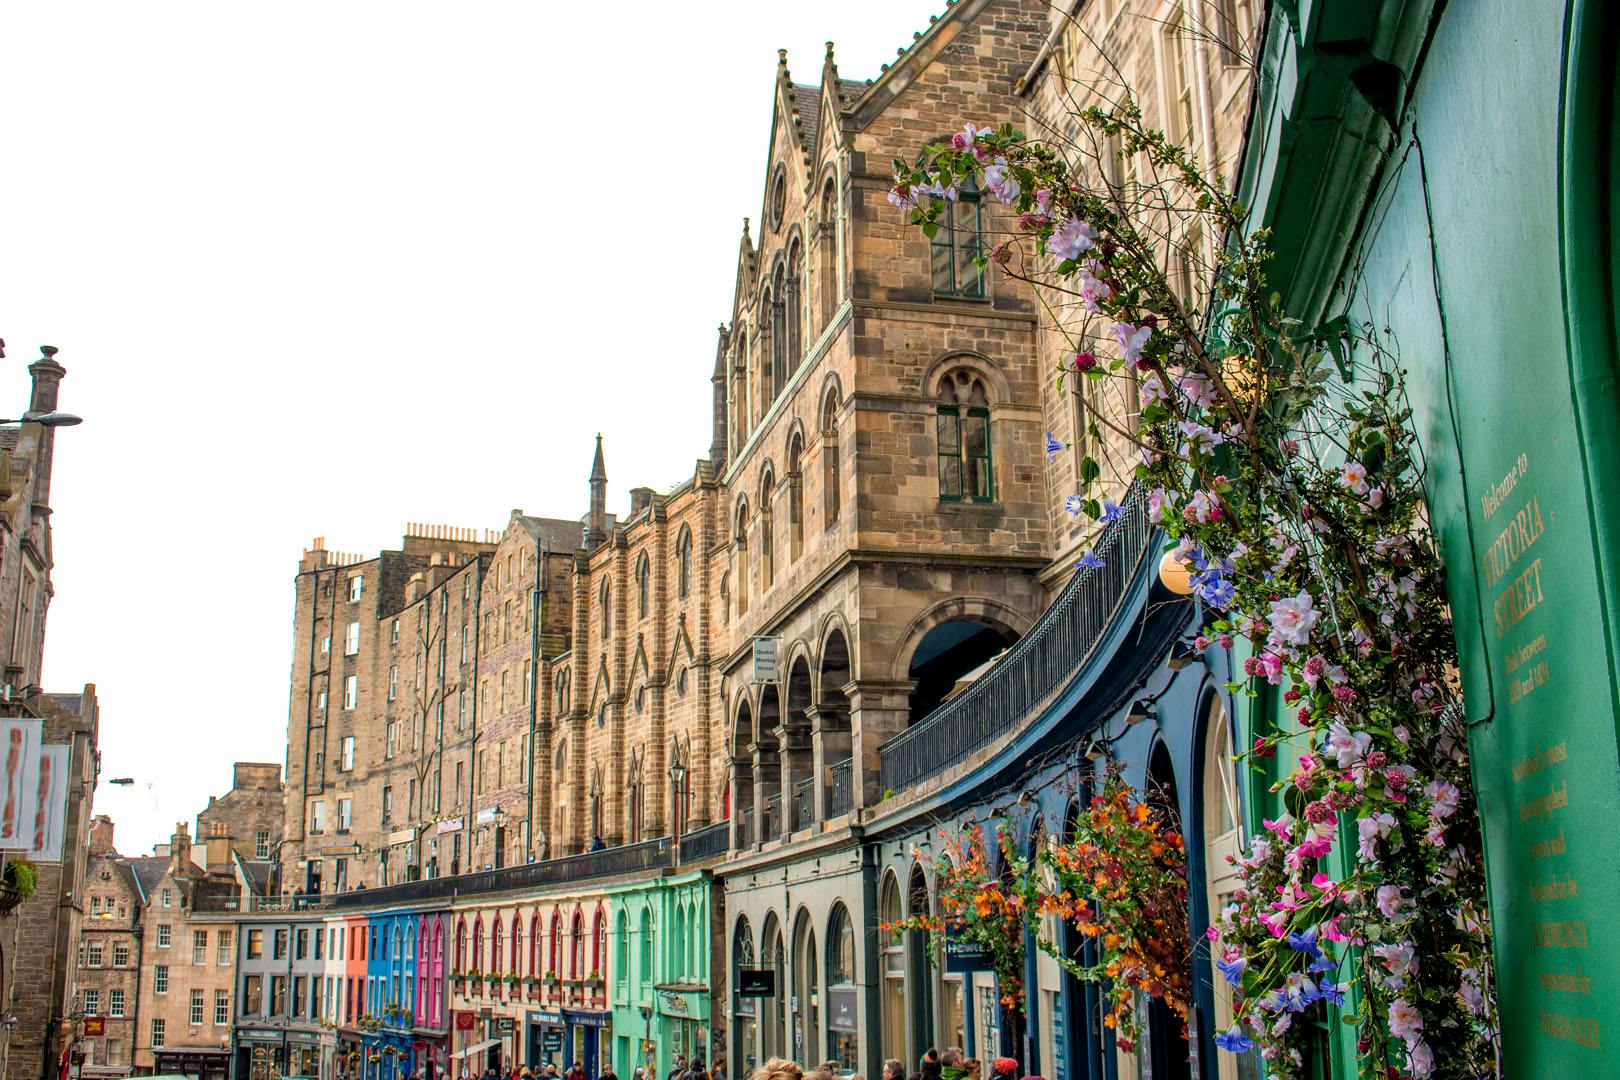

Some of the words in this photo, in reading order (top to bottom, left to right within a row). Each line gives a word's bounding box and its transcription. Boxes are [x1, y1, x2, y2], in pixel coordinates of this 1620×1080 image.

[1481, 465, 1517, 520] Welcome
[1517, 452, 1527, 478] to
[1482, 492, 1545, 590] VICTORIA
[1494, 557, 1544, 639] STREET
